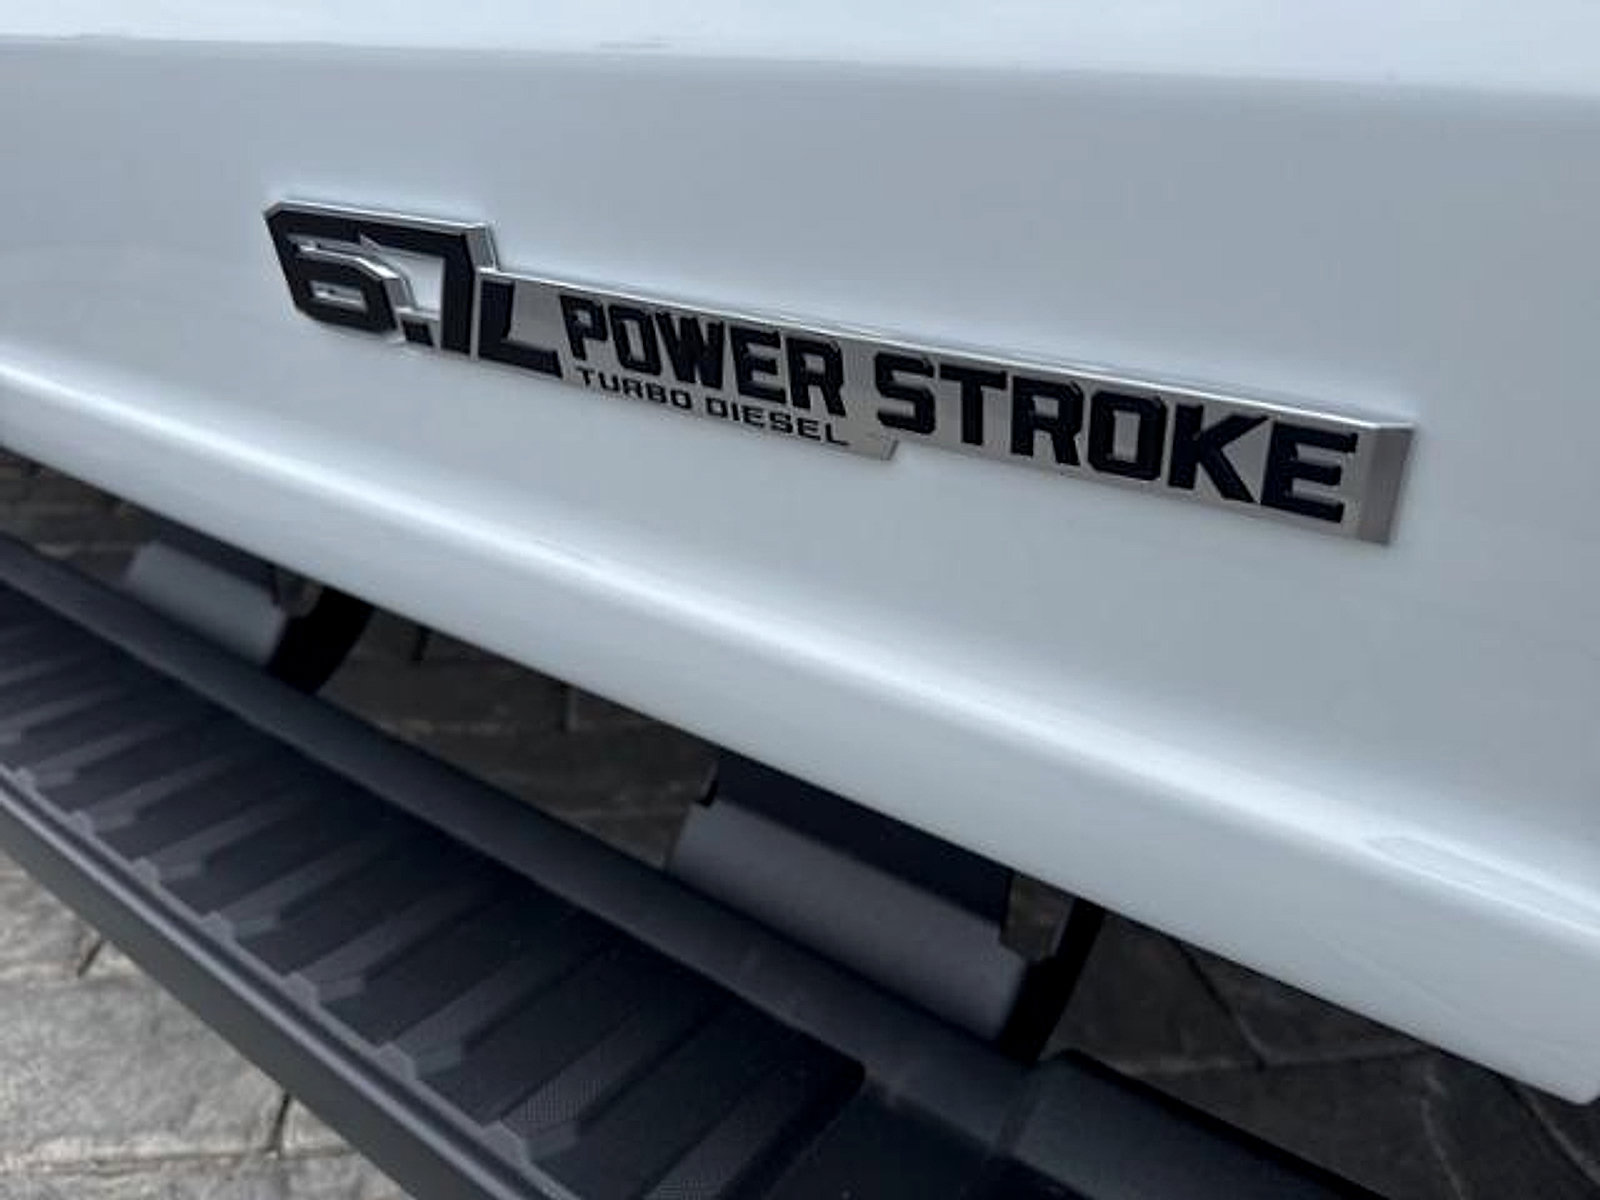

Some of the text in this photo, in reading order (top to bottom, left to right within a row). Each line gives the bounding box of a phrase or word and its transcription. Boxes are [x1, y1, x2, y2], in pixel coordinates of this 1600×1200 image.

[265, 202, 1358, 523] 6.7L POWER STROKE
[576, 365, 849, 447] TURBO DIESEL
